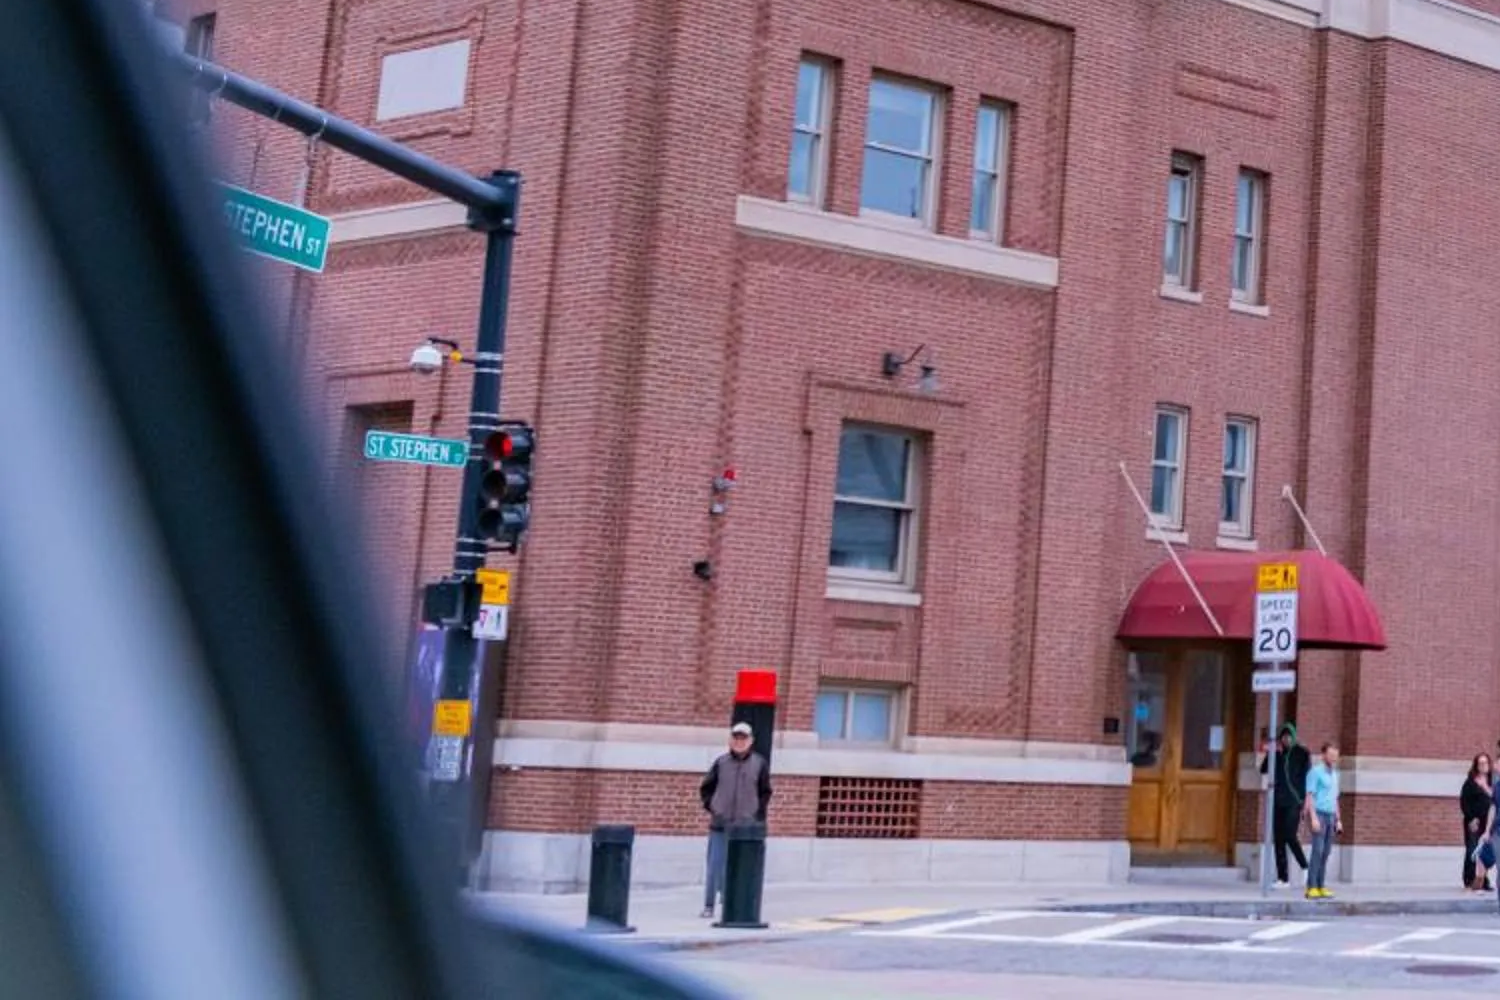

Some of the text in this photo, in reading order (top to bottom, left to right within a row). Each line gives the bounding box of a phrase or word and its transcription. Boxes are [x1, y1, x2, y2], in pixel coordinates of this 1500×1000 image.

[306, 237, 321, 256] ST
[368, 436, 386, 456] ST
[389, 438, 451, 462] STEPHEN
[1259, 627, 1292, 652] 20
